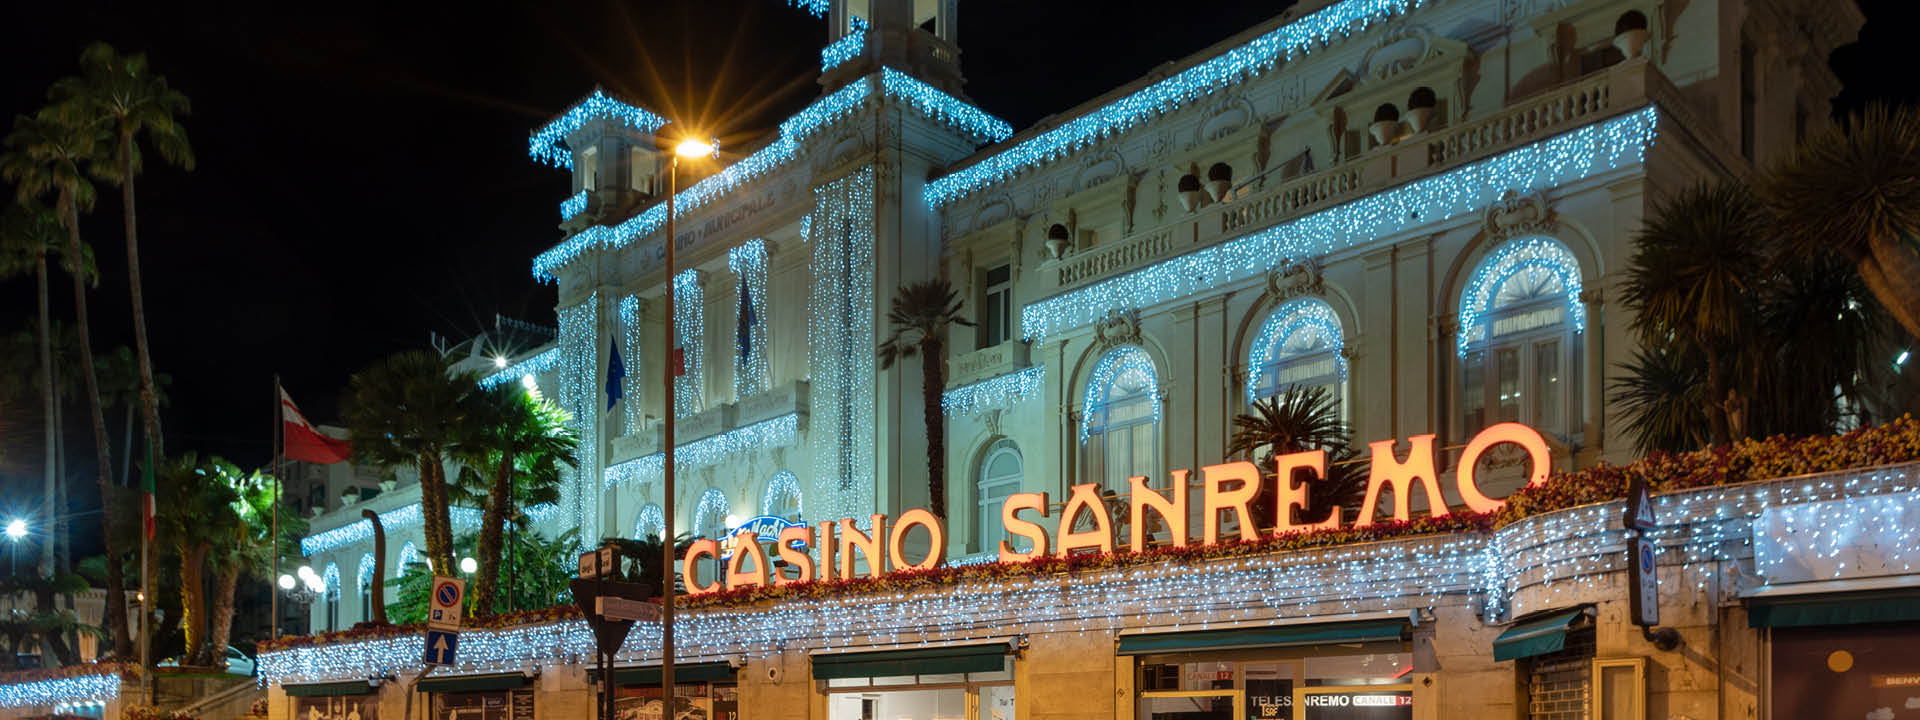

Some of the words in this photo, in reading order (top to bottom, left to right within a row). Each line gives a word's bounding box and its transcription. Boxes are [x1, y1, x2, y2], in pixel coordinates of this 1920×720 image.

[683, 508, 944, 594] CASINO
[999, 422, 1551, 565] SANREMO
[1220, 672, 1230, 680] 12
[1400, 695, 1413, 705] 12
